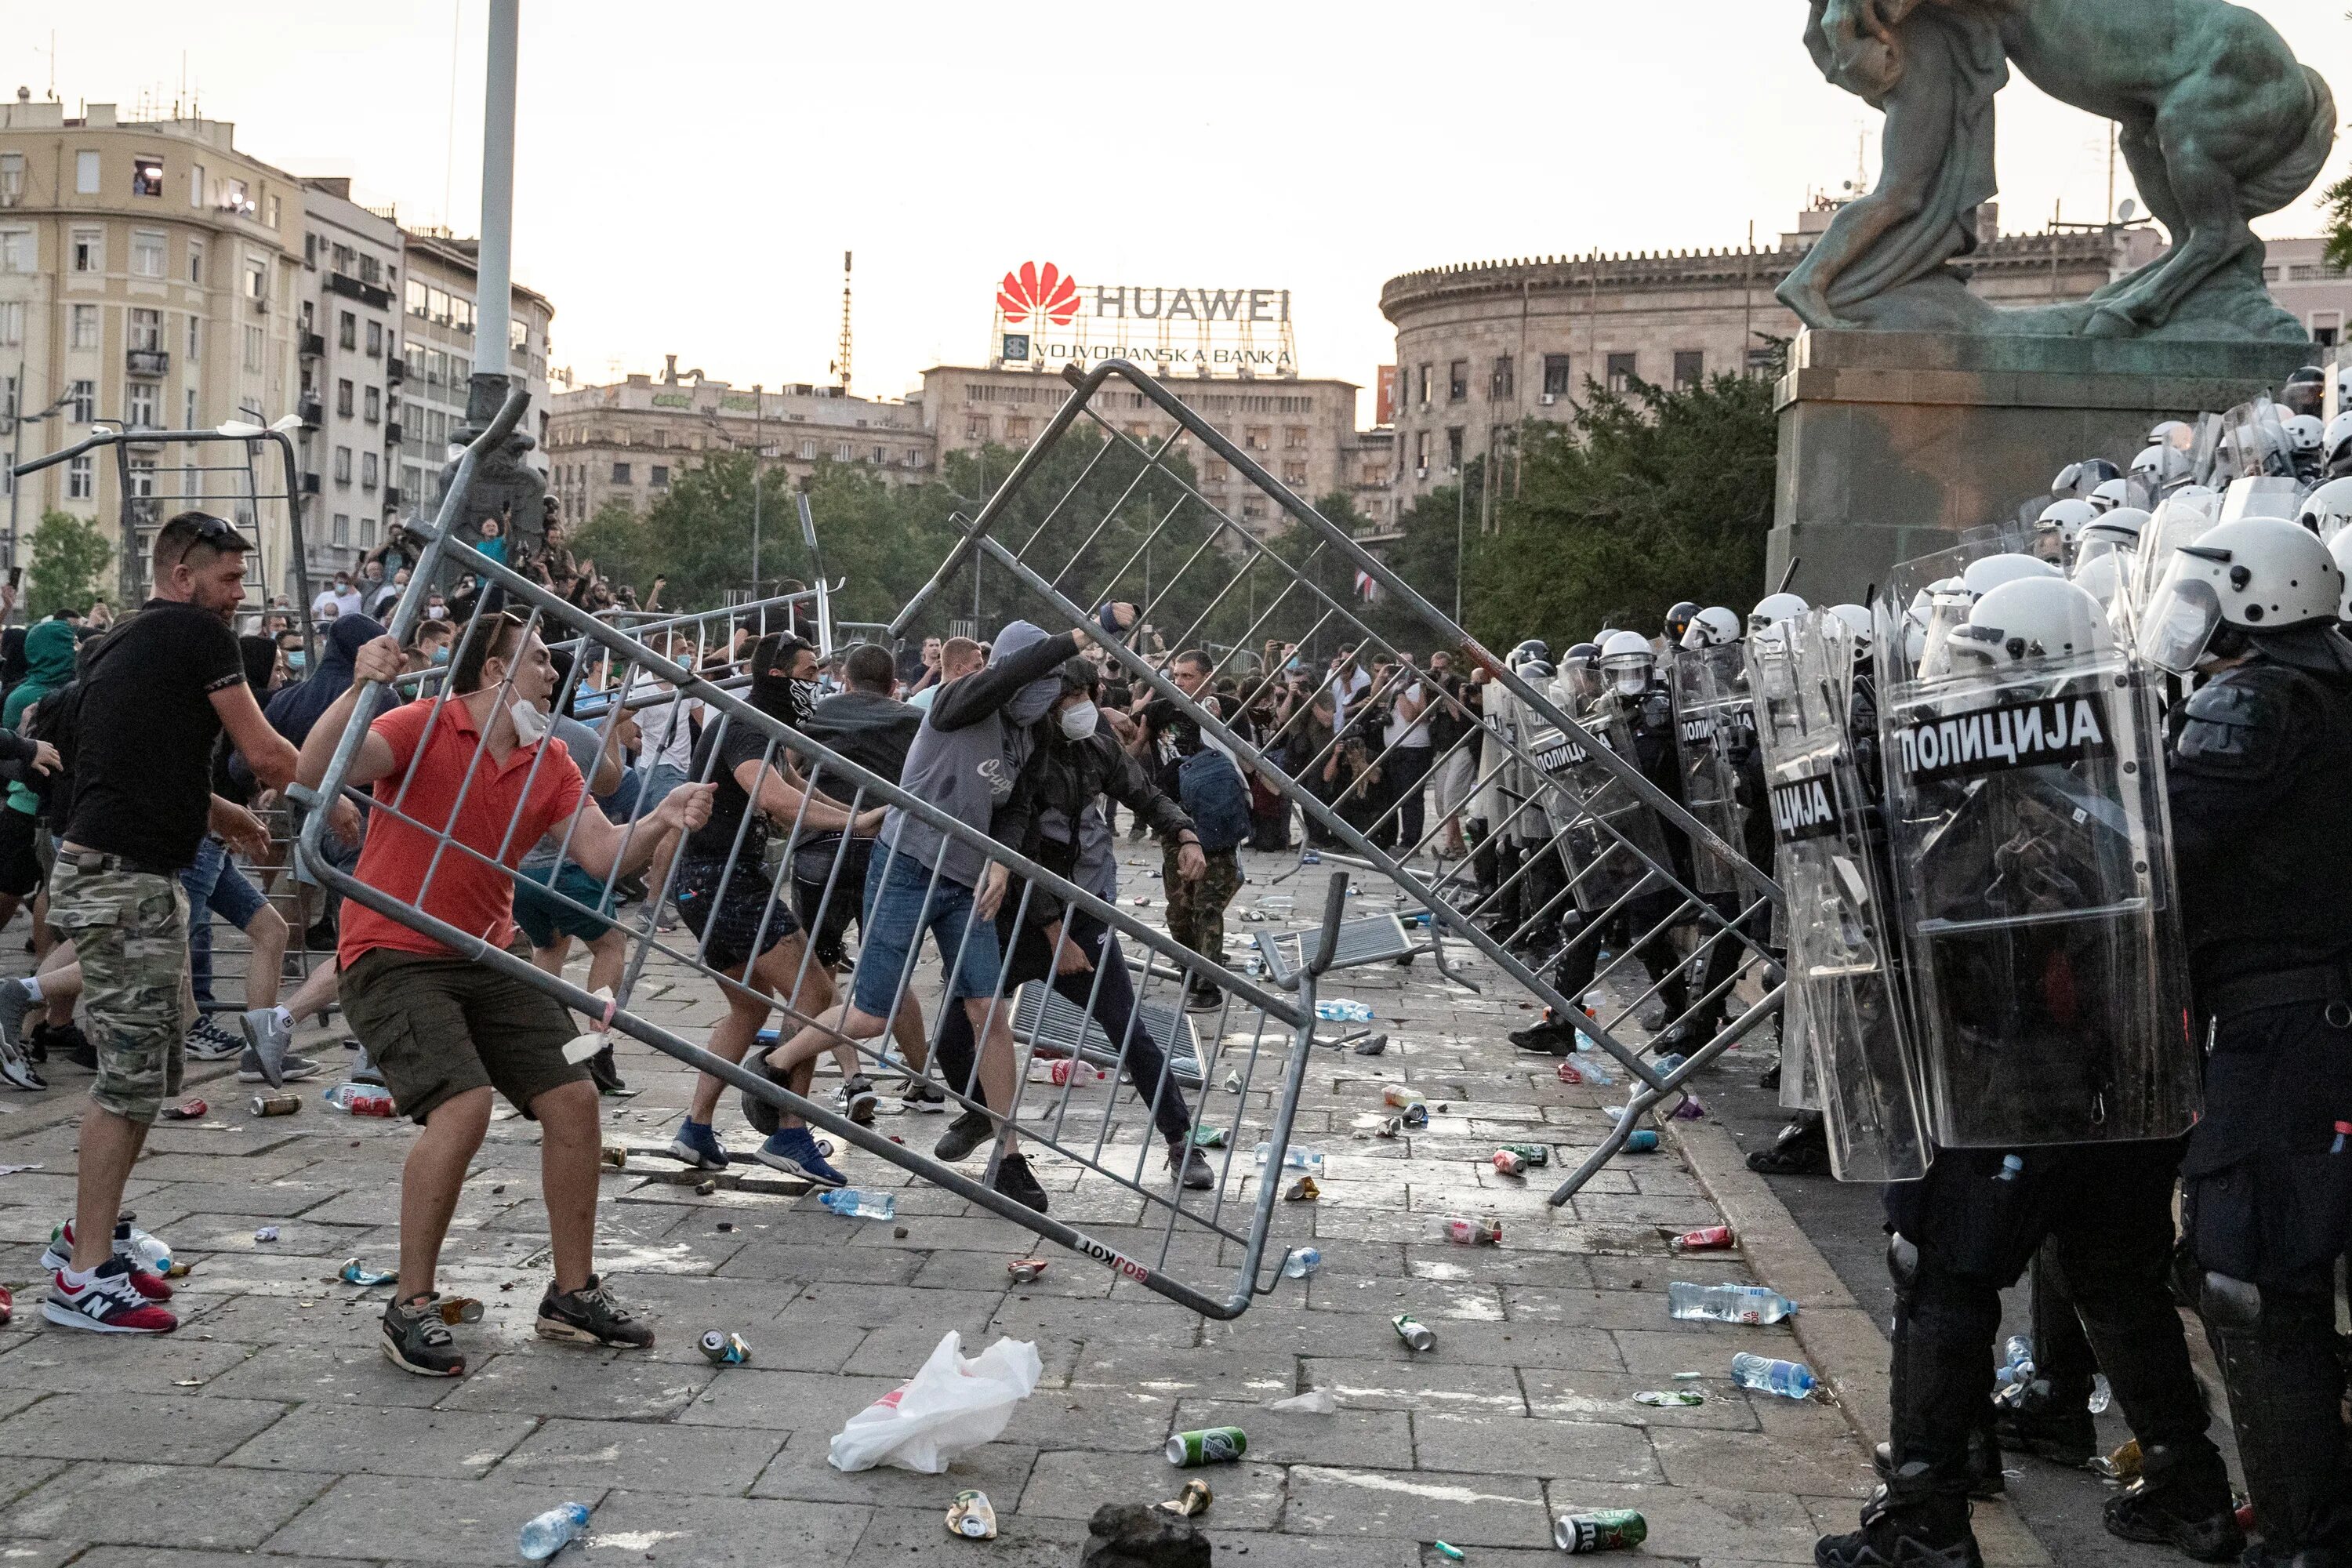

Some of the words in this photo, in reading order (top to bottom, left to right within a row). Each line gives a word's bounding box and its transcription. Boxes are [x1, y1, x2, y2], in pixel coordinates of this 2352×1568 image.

[1097, 285, 1289, 321] HUAWEI
[1034, 343, 1206, 363] VOJVOĐANSKA
[1214, 349, 1292, 365] BANKA
[1537, 731, 1613, 771] ПОЛИЦА
[1900, 699, 2104, 774] ПОЛИЦИЈА
[1774, 779, 1834, 837] ЦИЈА
[1080, 1240, 1149, 1282] BOJKOT
[82, 1294, 114, 1319] N
